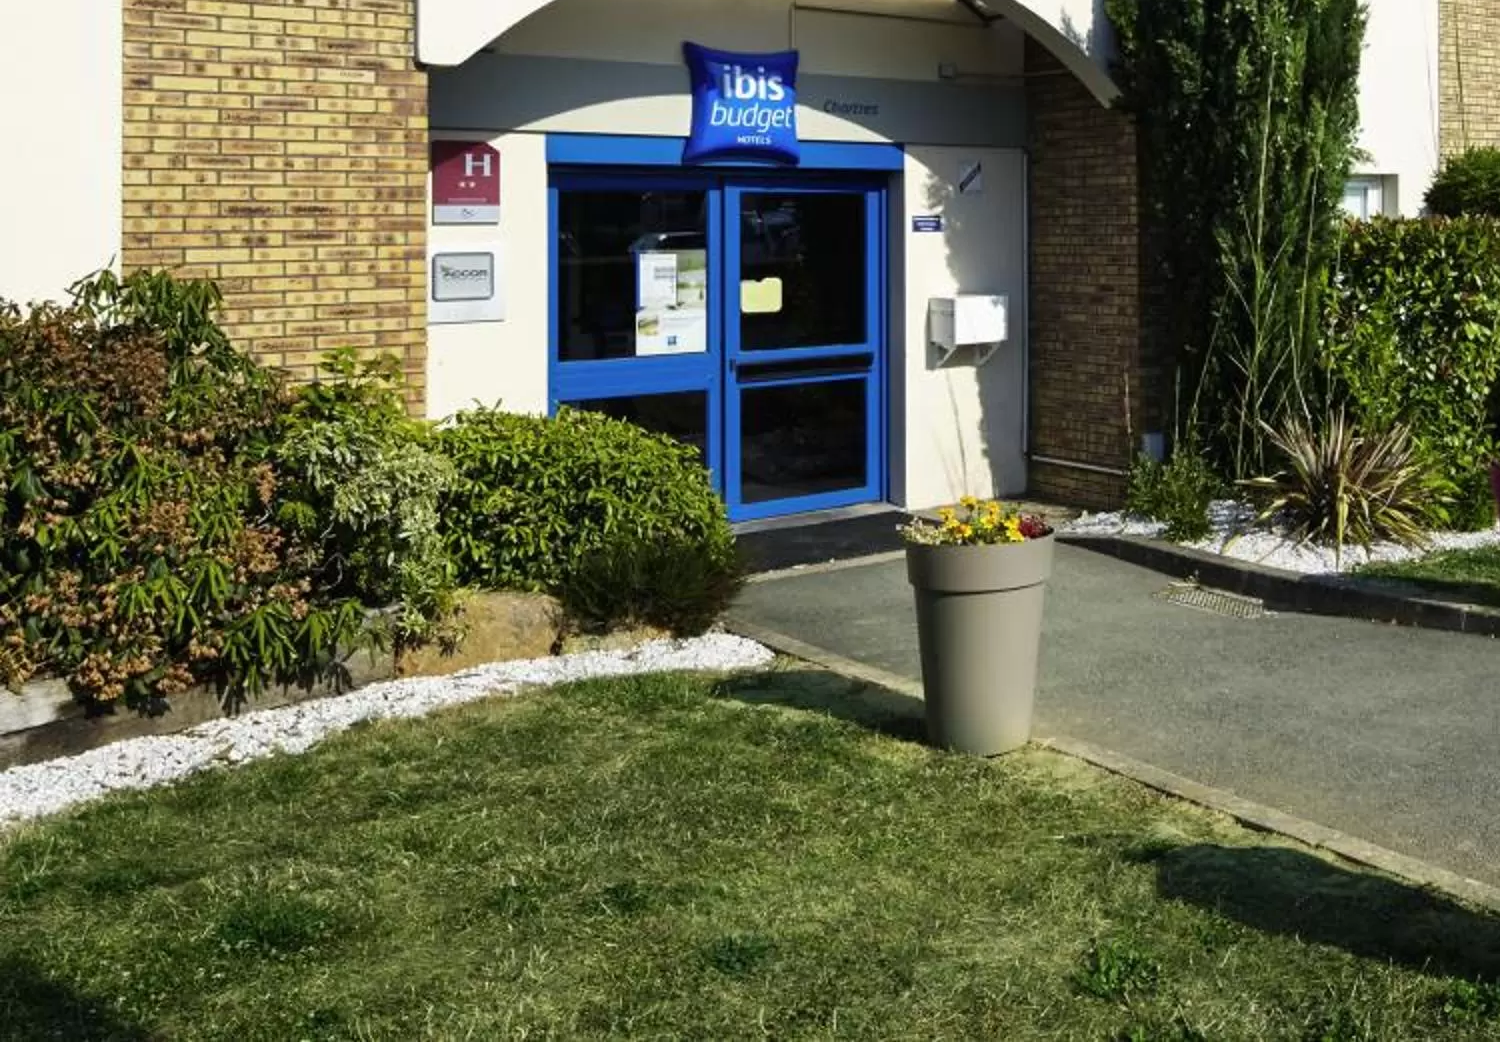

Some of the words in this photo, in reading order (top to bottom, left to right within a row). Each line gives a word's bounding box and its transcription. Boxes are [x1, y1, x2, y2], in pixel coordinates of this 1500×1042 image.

[723, 64, 785, 101] ibis
[710, 99, 793, 133] budget
[737, 135, 771, 145] HOTELS
[463, 153, 494, 177] H
